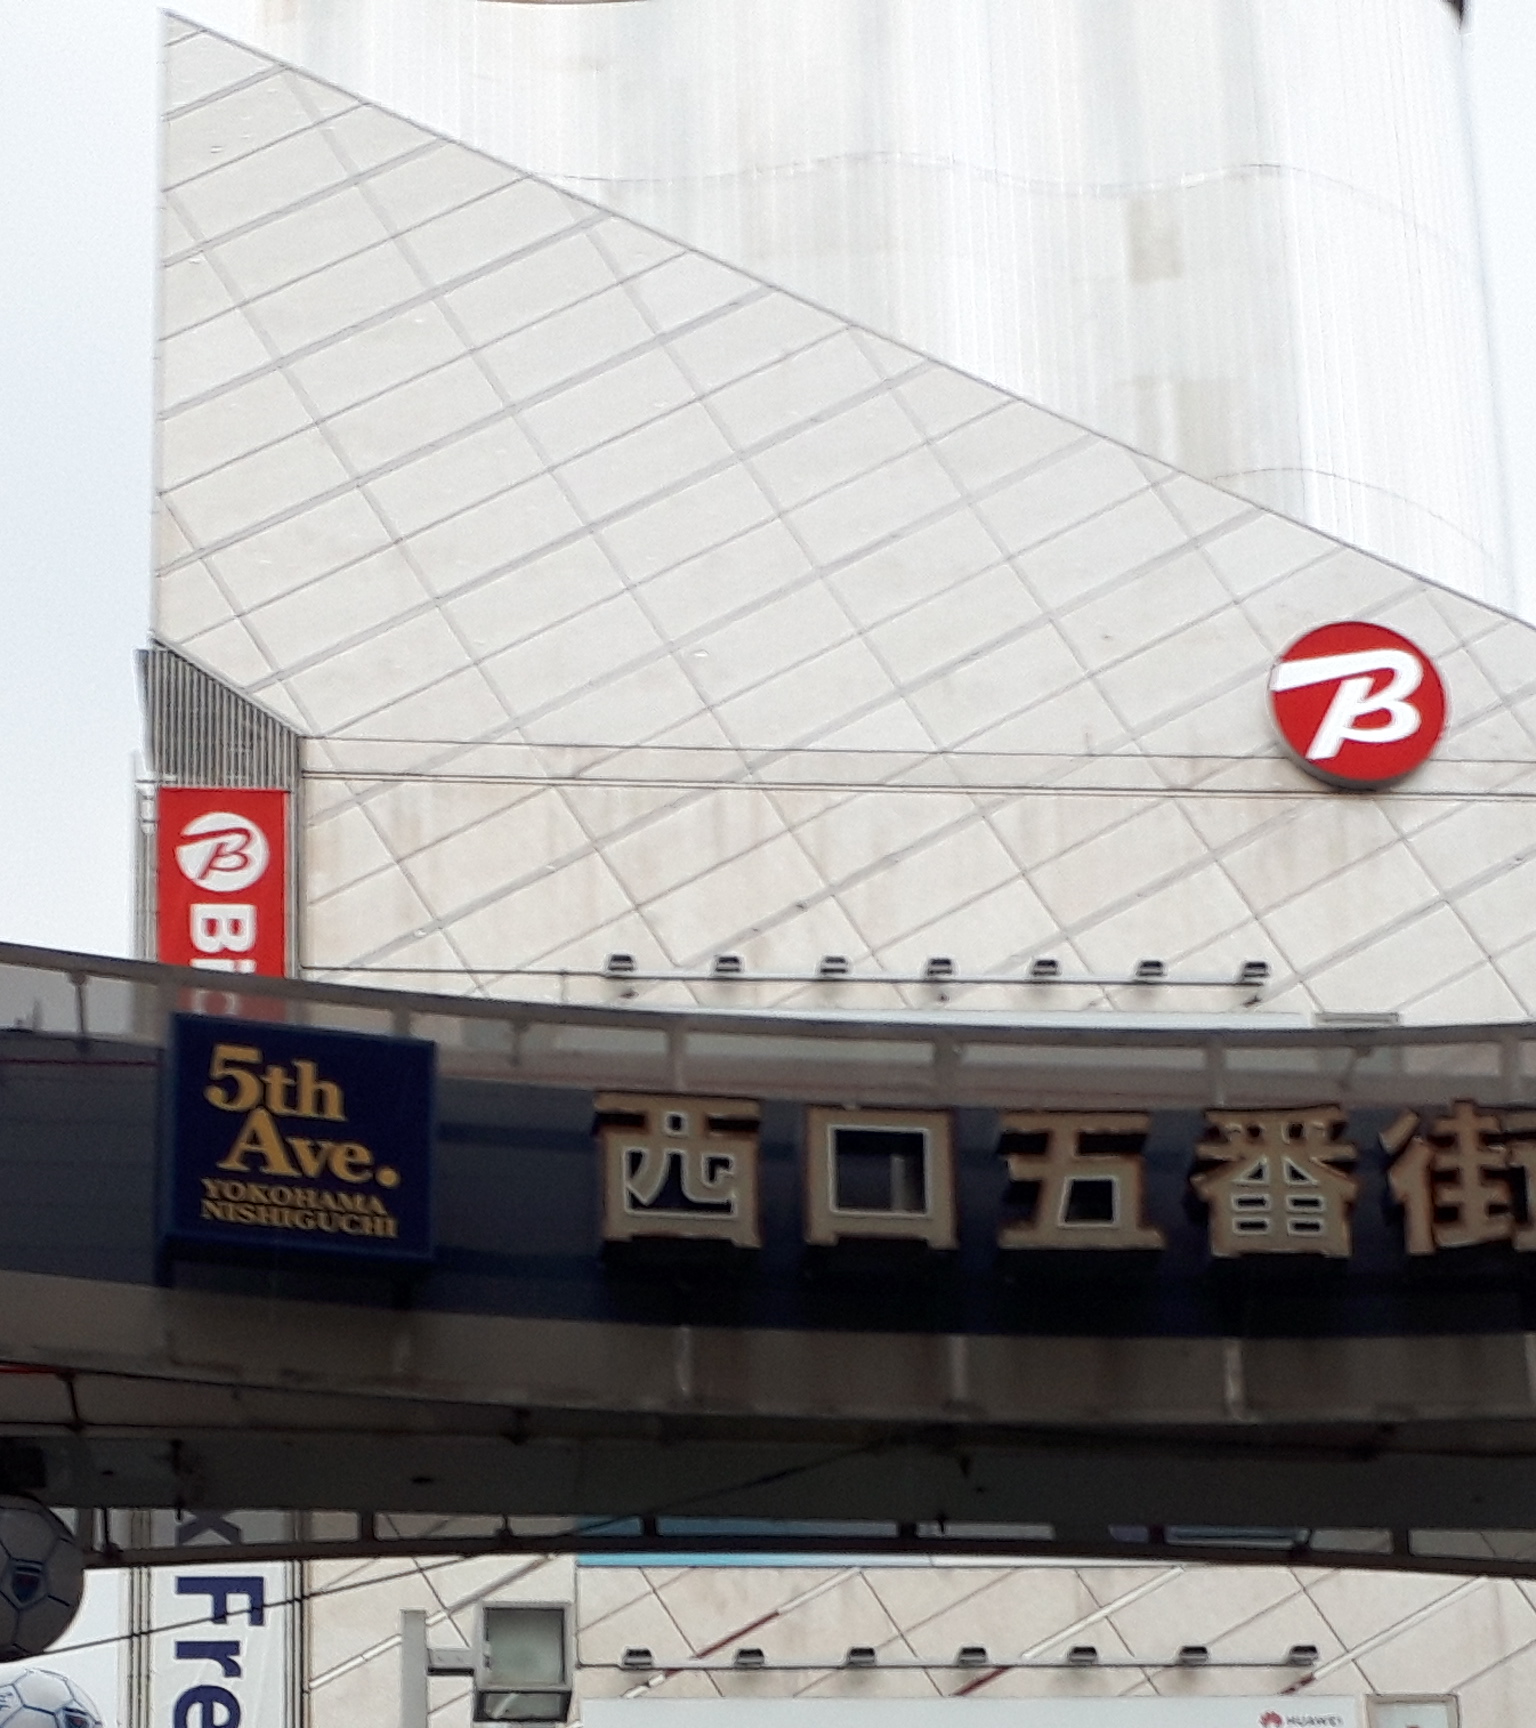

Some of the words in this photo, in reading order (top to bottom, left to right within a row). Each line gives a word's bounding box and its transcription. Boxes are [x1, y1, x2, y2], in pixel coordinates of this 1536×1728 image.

[204, 1043, 349, 1122] 5th
[218, 1106, 402, 1188] Ave.
[200, 1177, 389, 1217] YOKOHAMA
[200, 1199, 399, 1239] NISHIGUCHI
